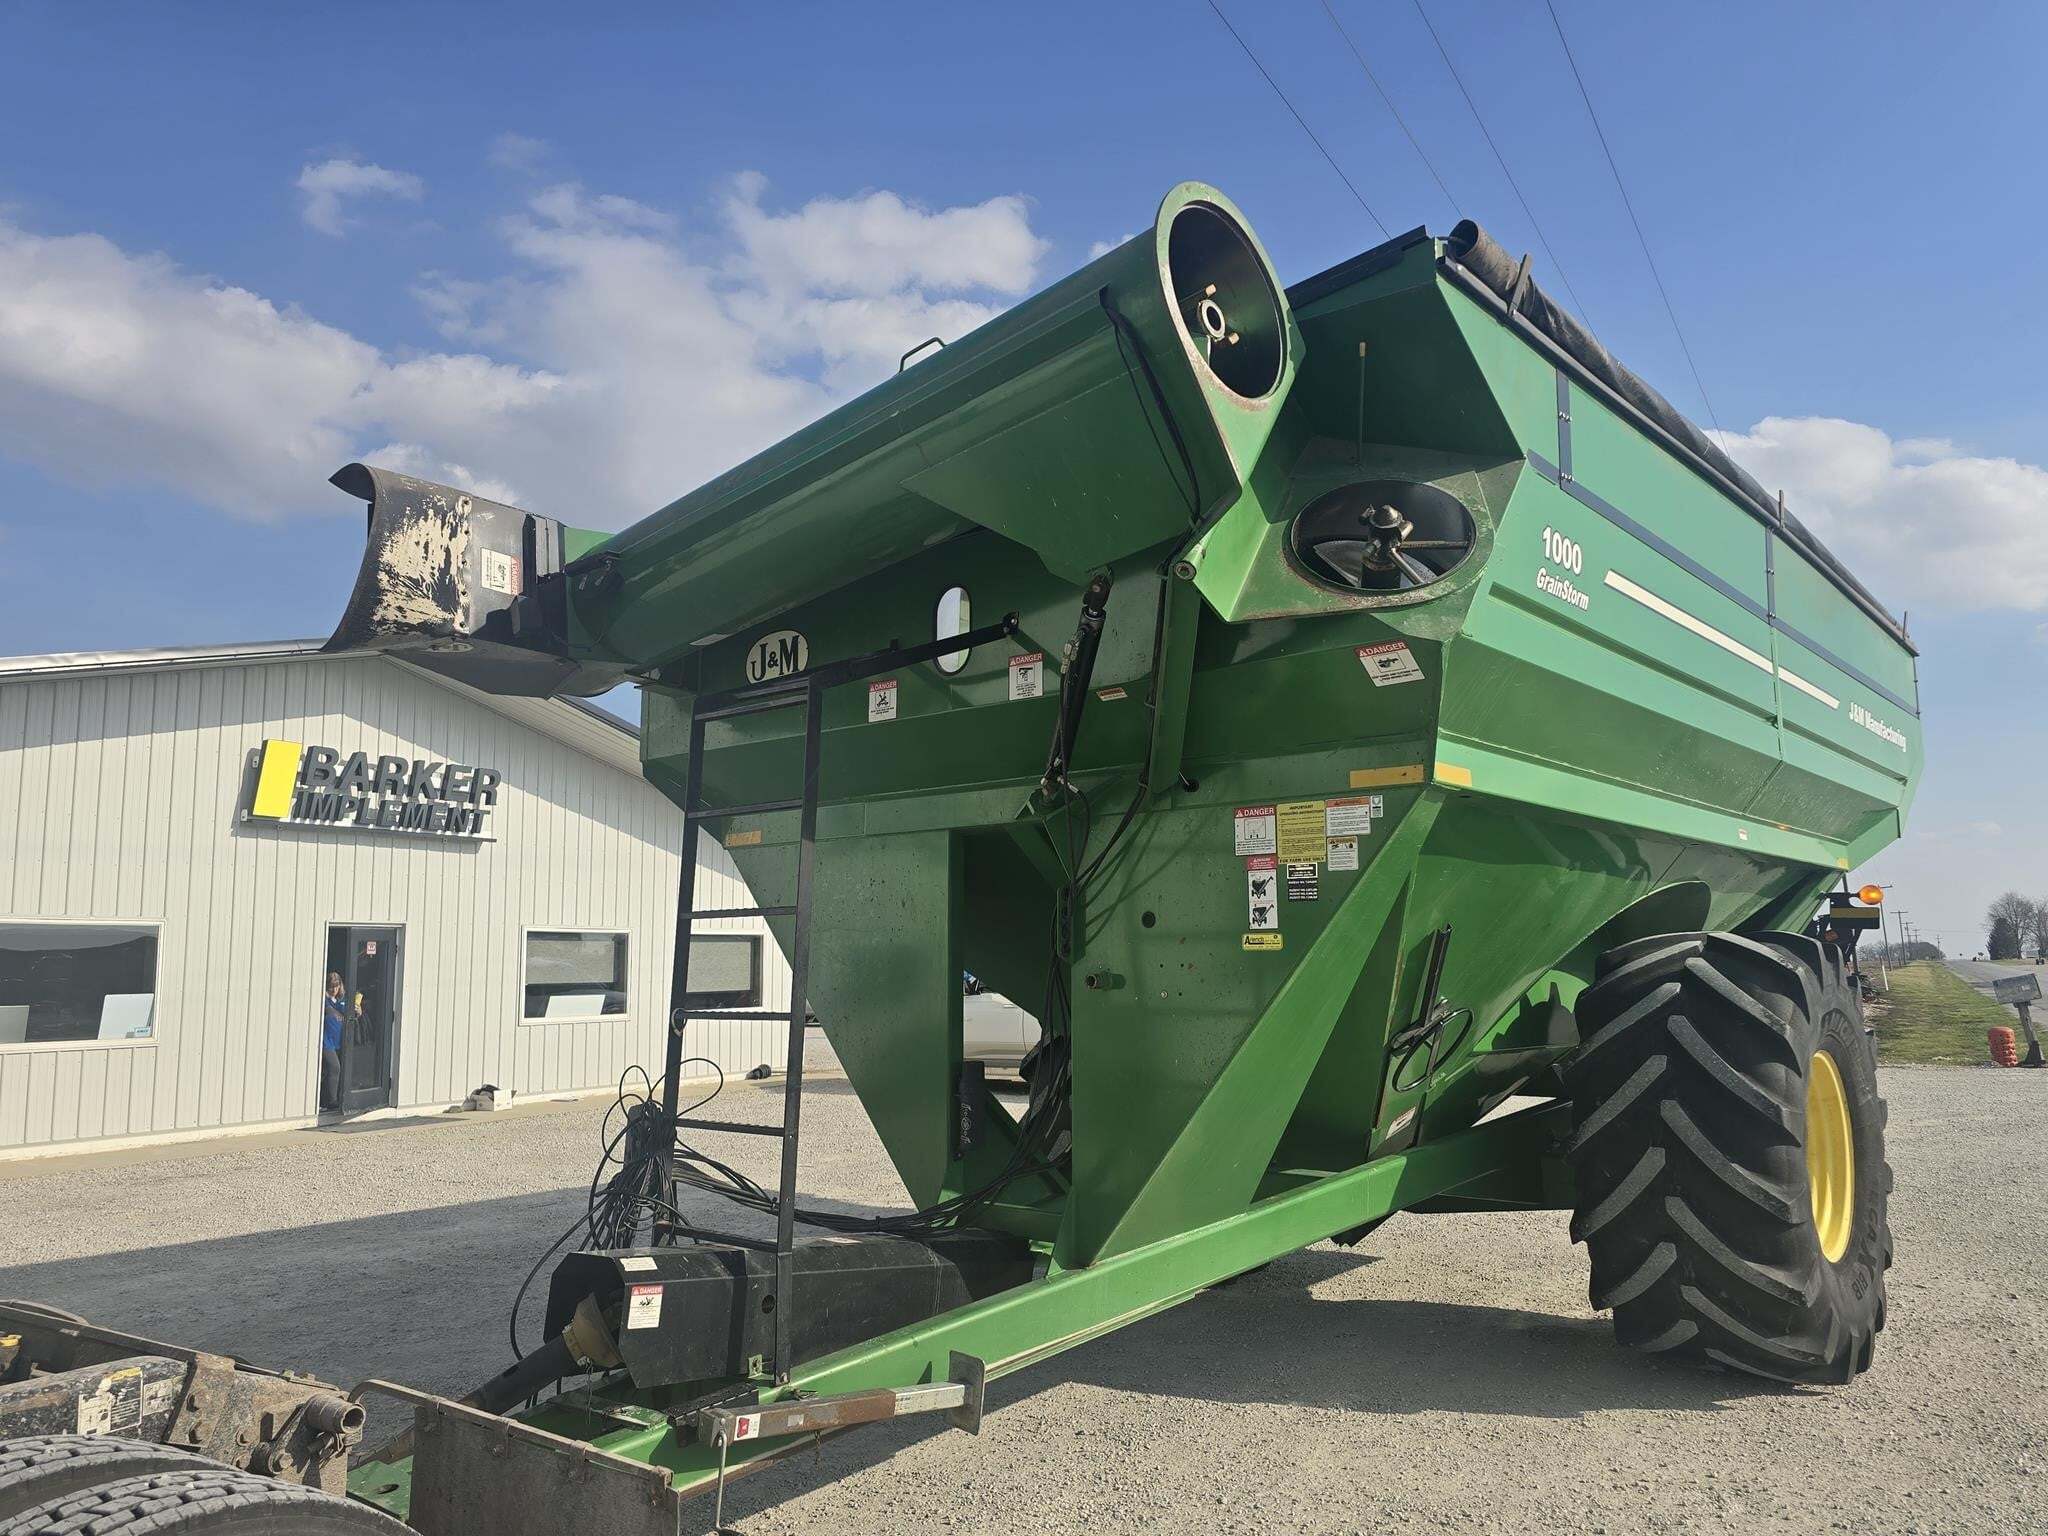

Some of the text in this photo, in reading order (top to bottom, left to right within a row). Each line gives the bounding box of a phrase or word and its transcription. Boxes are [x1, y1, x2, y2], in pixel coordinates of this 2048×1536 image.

[1542, 526, 1583, 576] 1000
[1536, 567, 1590, 611] GrainStorm
[750, 634, 800, 681] J&M
[1016, 653, 1042, 664] DANGER
[1365, 641, 1407, 656] DANGER
[875, 680, 897, 691] DANGER
[300, 745, 501, 806] BARKER
[292, 791, 491, 834] IMPLEMENT
[1243, 807, 1275, 817] DANGER
[640, 1286, 663, 1295] DANGER
